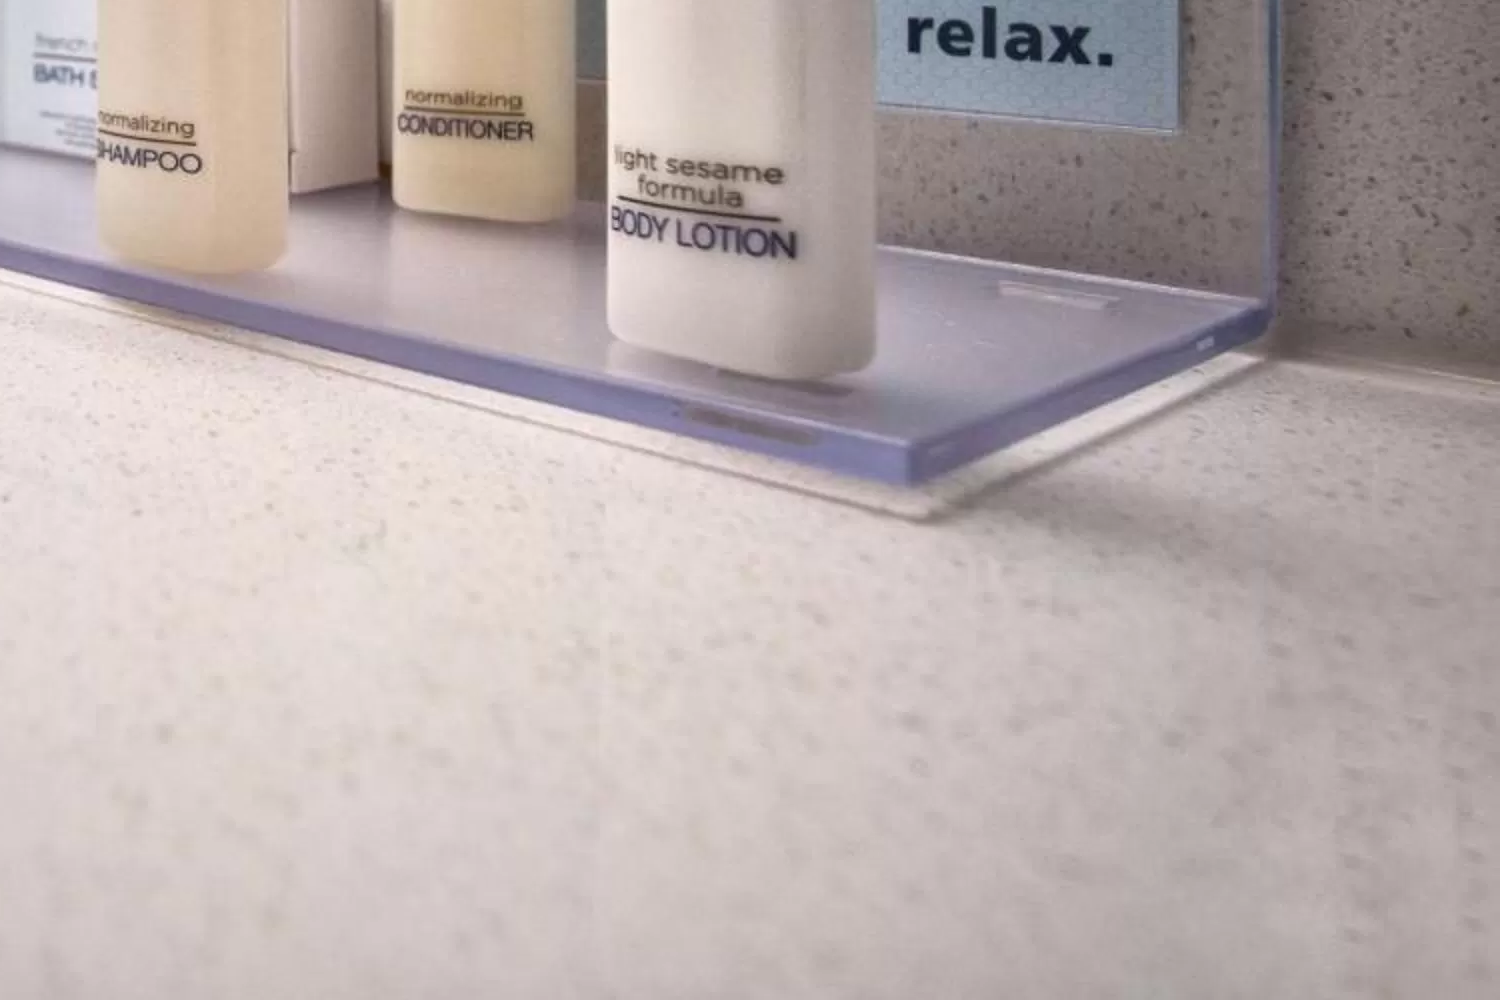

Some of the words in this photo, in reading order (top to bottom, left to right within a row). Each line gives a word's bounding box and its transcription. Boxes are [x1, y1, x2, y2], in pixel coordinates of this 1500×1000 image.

[907, 5, 1113, 67] relax.
[405, 89, 523, 111] normalizing
[397, 113, 534, 141] CONDITIONER
[614, 144, 657, 171] light
[665, 157, 784, 185] sesame
[638, 174, 743, 208] formula
[611, 205, 670, 242] BODY
[676, 217, 797, 259] LOTION
